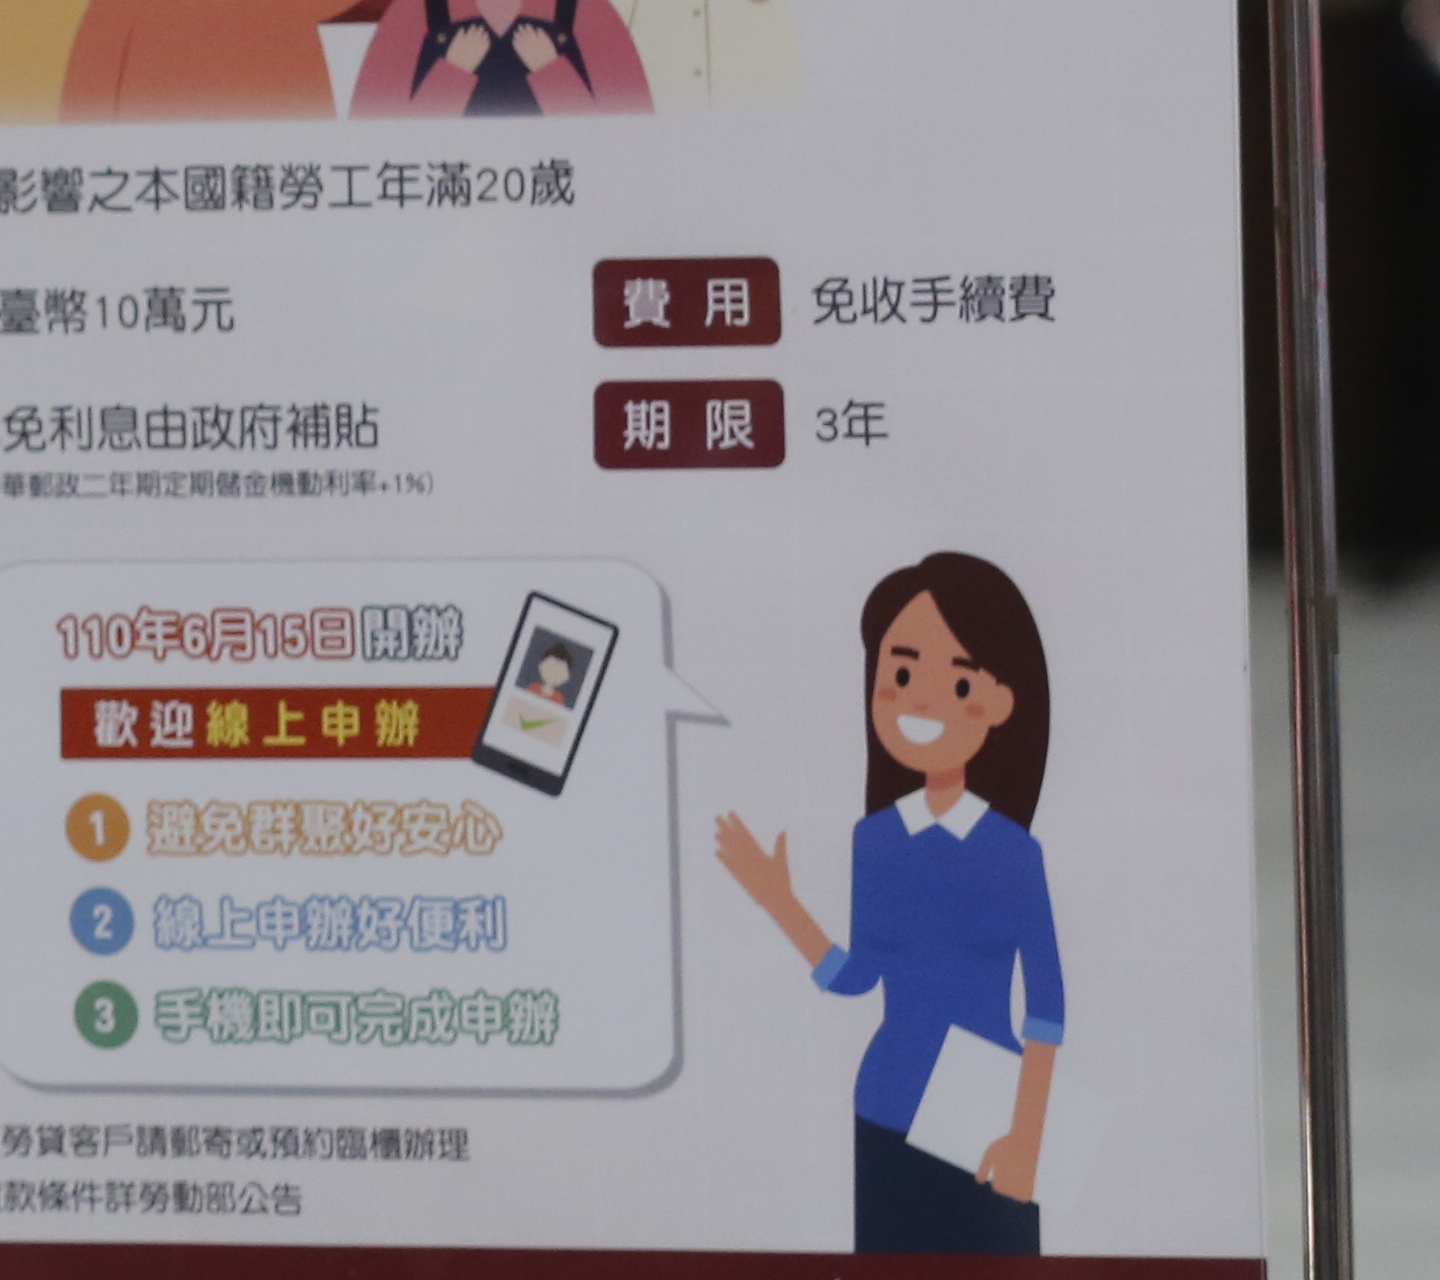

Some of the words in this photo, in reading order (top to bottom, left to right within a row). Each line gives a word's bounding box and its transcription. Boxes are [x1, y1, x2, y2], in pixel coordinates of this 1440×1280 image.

[623, 277, 750, 329] 費用
[812, 275, 1056, 324] 免收手續費
[623, 399, 754, 450] 期限
[815, 398, 888, 447] 3年
[56, 604, 464, 662] 110年6月15日開辦
[94, 699, 420, 748] 歡迎線上申辦
[145, 798, 504, 858] 避免群聚好安心
[153, 894, 508, 952] 線上申辦好便利
[154, 988, 560, 1046] 手機即可完成申辦
